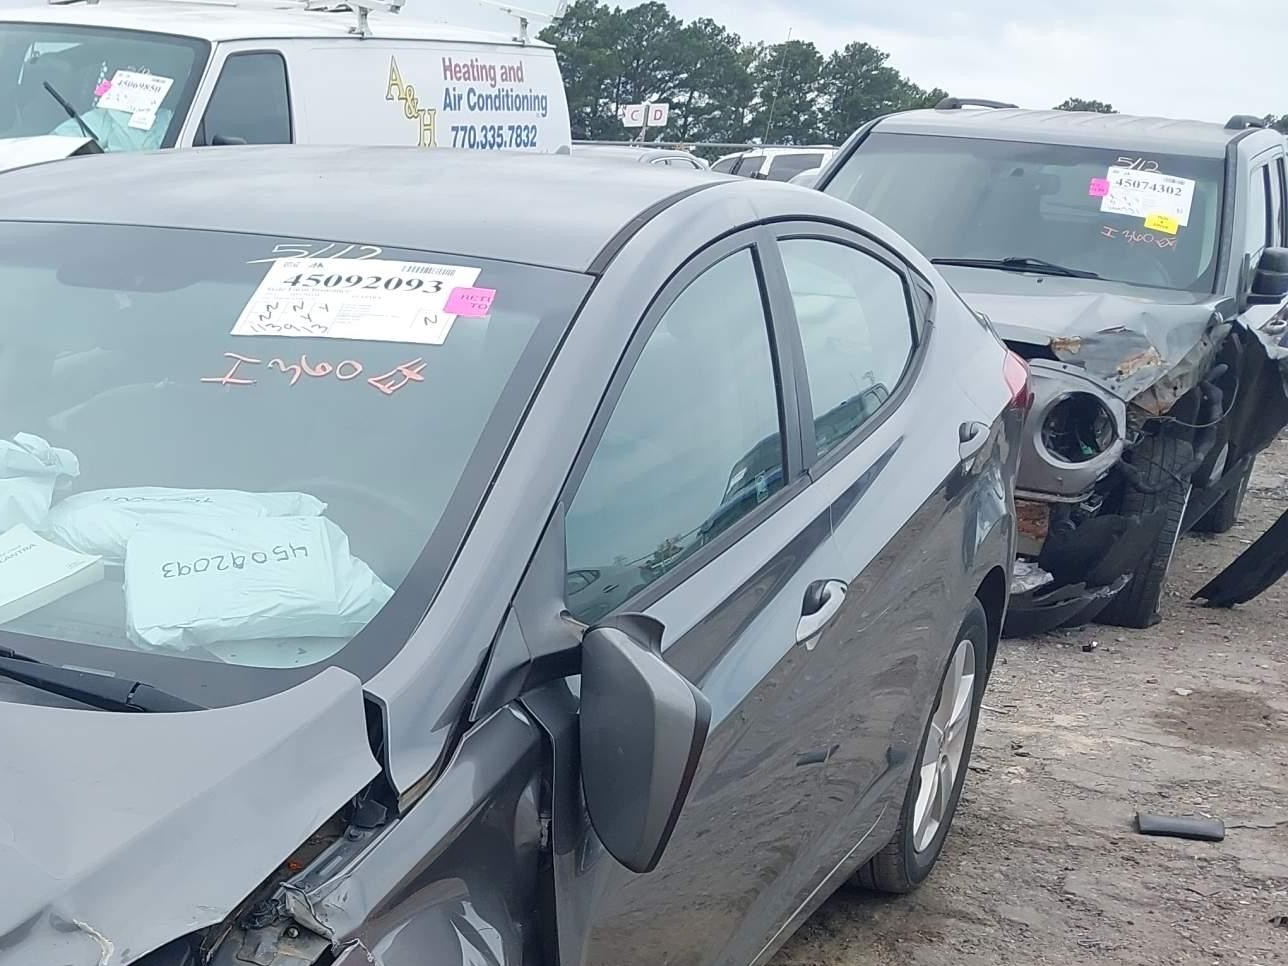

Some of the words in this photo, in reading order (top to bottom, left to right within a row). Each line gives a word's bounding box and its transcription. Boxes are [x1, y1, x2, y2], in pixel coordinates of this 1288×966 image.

[442, 57, 497, 87] Heating
[500, 60, 524, 83] and
[443, 88, 462, 112] Air
[467, 87, 548, 118] Conditioning
[631, 109, 640, 121] C
[653, 109, 663, 121] D
[451, 125, 538, 150] 770.335.7832
[1116, 178, 1182, 196] 45074302
[282, 273, 443, 294] 45092093
[162, 543, 309, 578] 45092093
